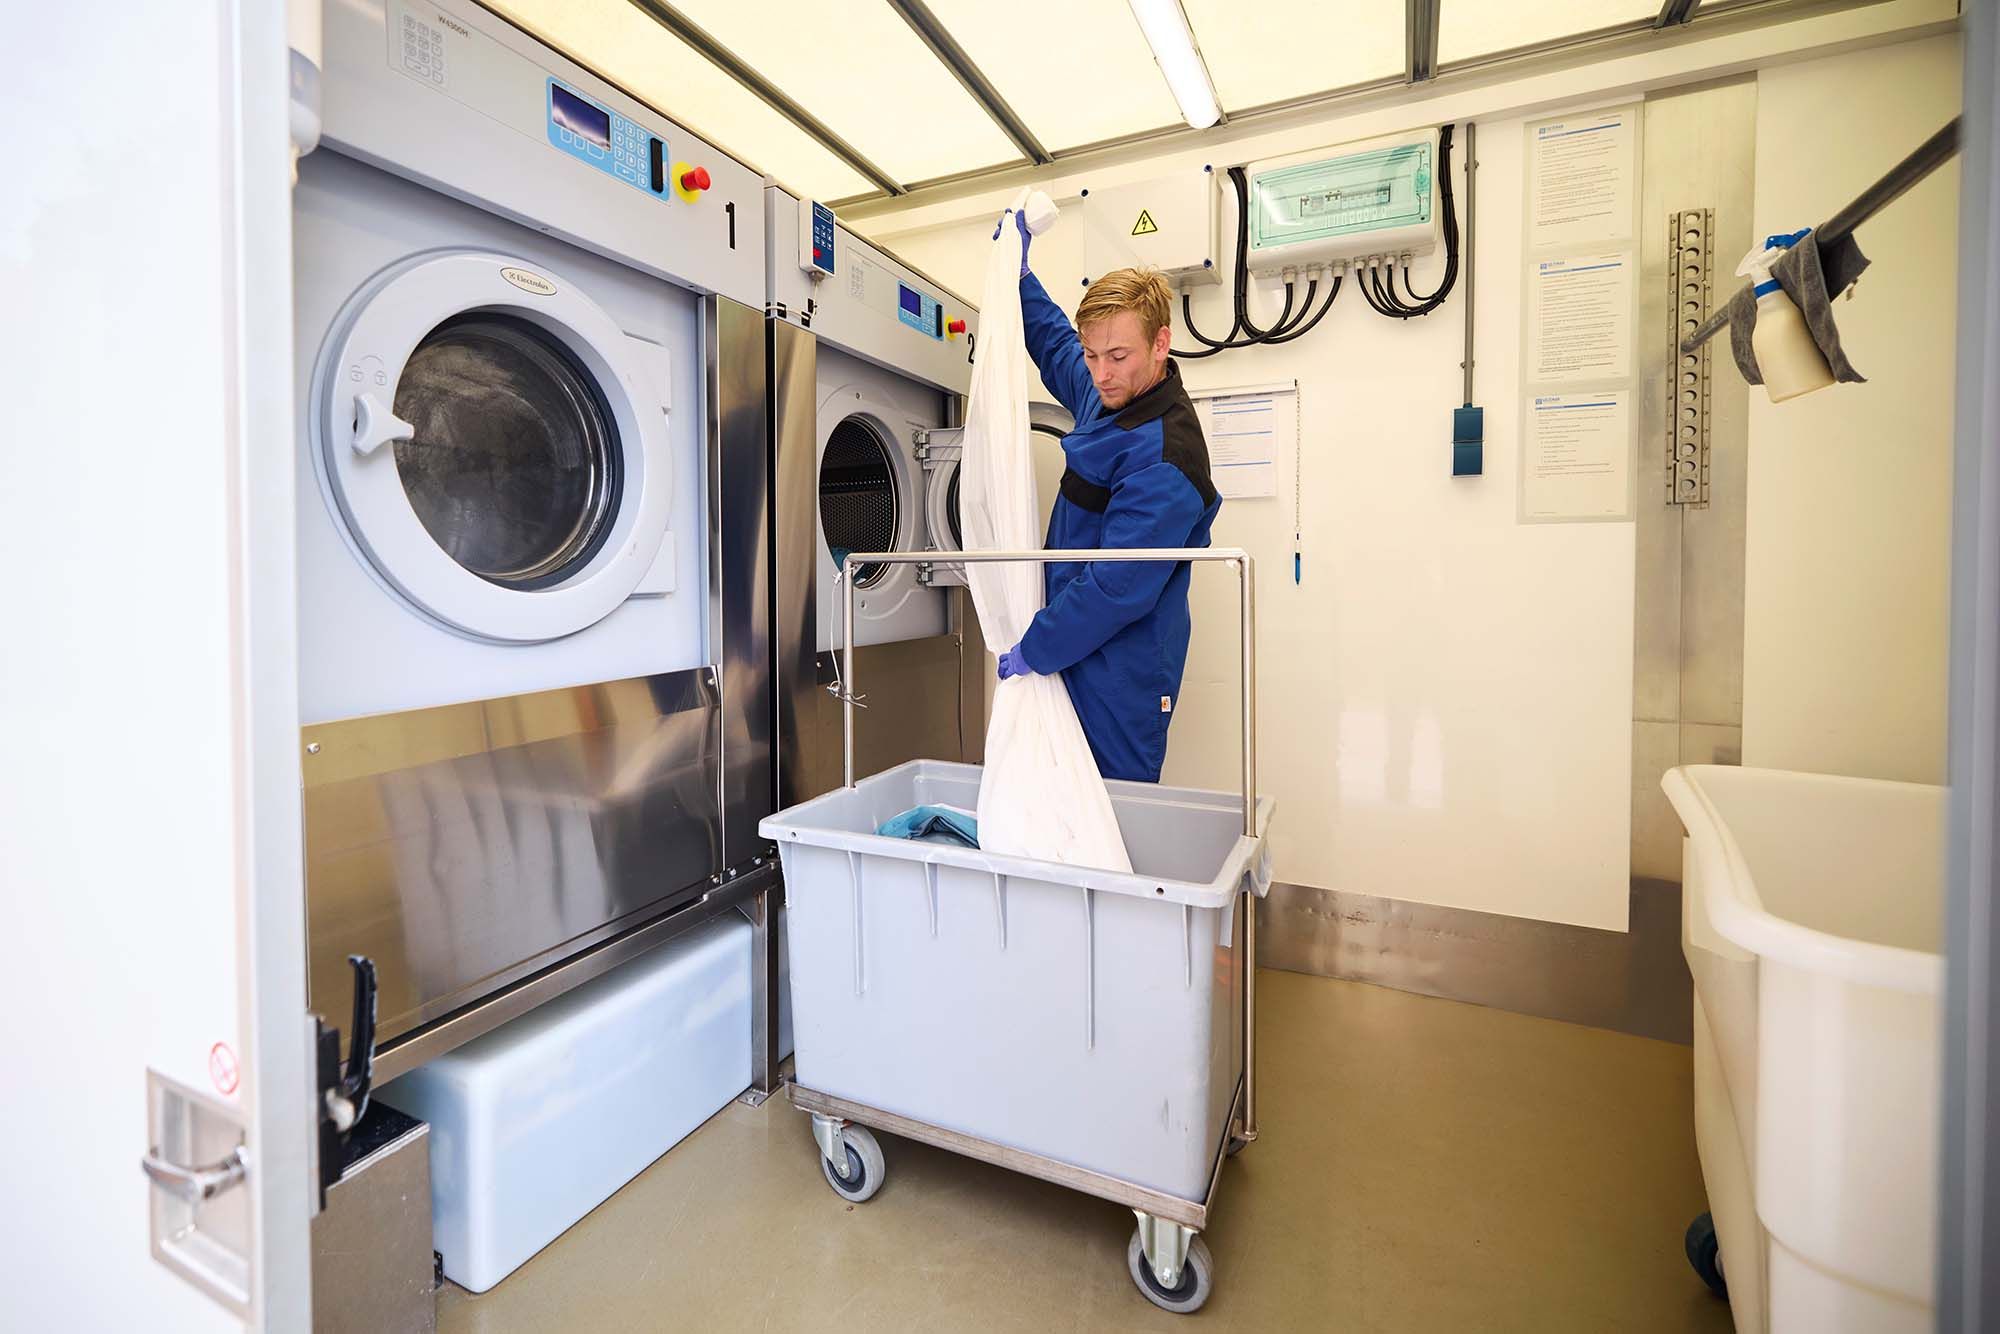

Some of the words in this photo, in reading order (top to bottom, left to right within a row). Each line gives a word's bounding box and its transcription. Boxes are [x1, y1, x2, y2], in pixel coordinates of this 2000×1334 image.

[725, 200, 736, 250] 1
[516, 274, 549, 291] Electrolux
[967, 332, 976, 365] 2
